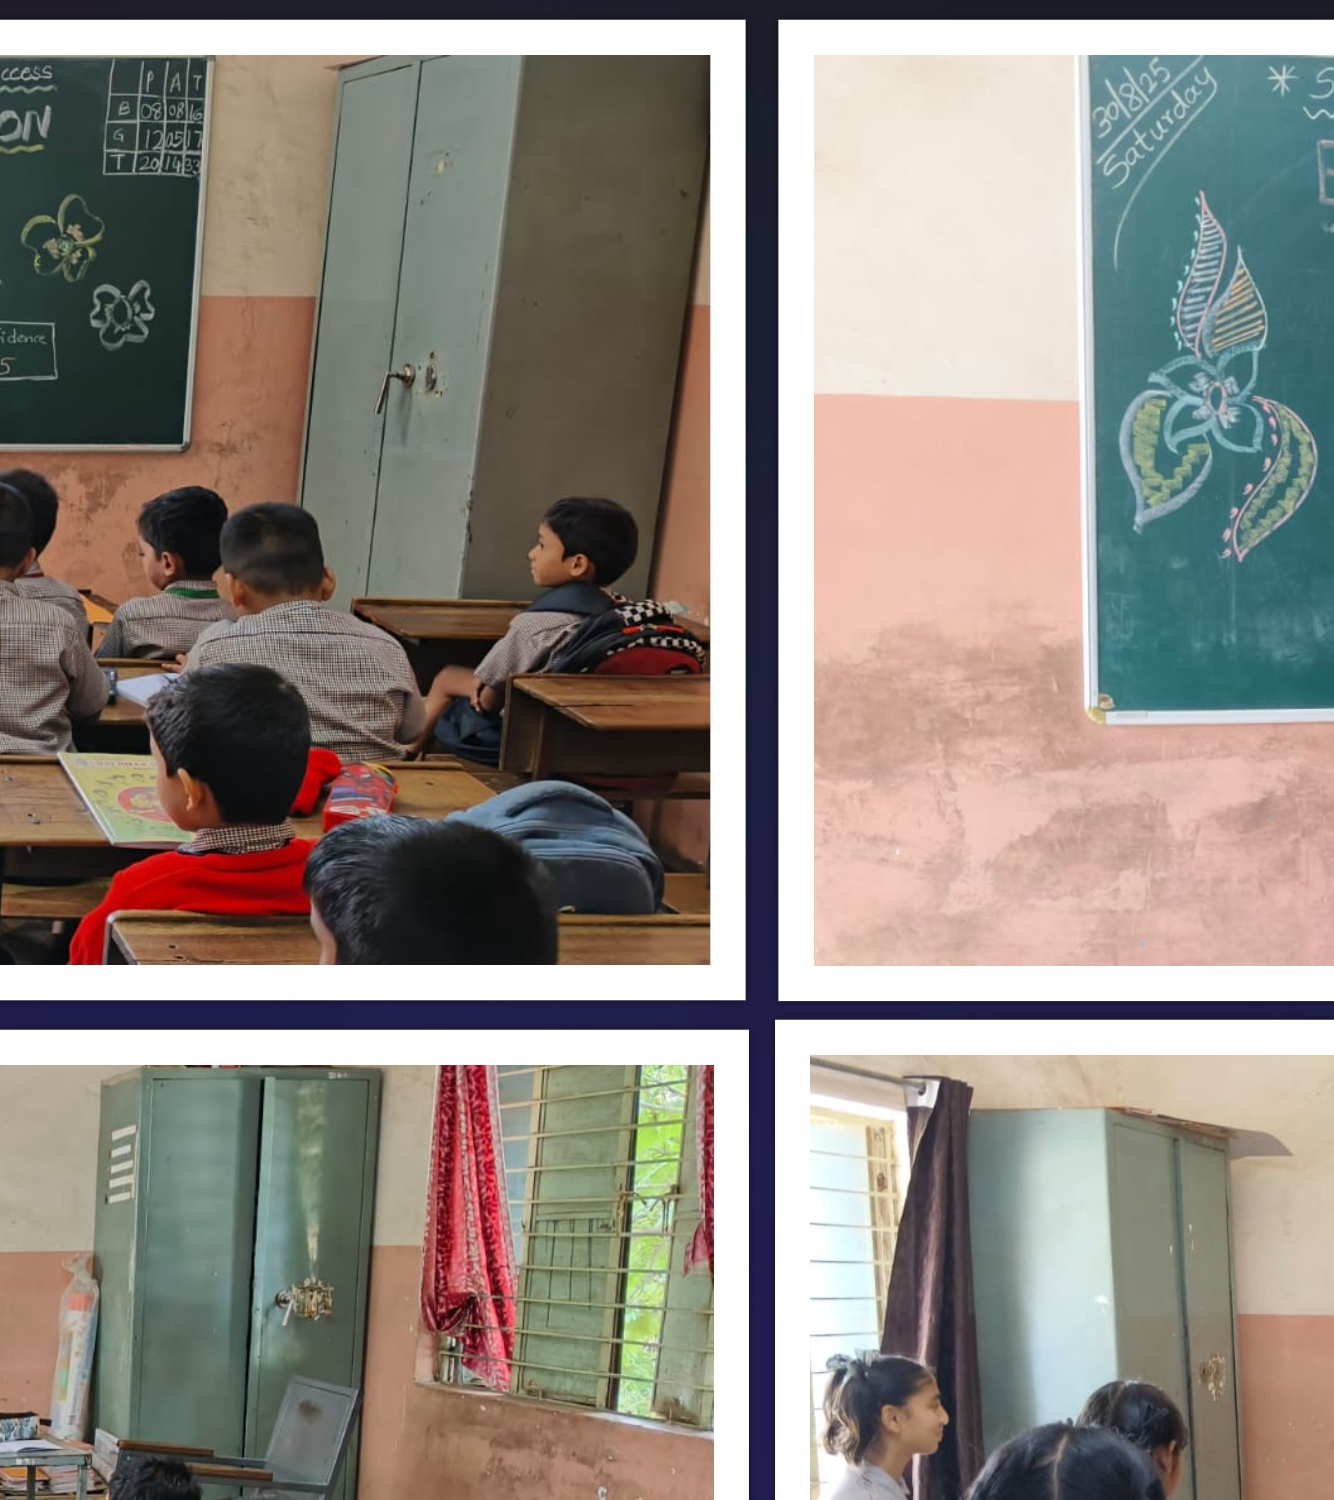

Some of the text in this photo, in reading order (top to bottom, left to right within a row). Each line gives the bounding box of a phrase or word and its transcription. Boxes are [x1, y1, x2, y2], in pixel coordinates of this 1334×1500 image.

[146, 70, 202, 93] P A T
[1092, 57, 1171, 137] 30/8/25
[118, 101, 203, 120] B 08 08 16
[1102, 66, 1218, 189] Saturday
[113, 128, 203, 150] G 12 05 17
[109, 154, 125, 170] T
[139, 156, 159, 170] 20
[165, 155, 181, 173] 14
[0, 357, 16, 375] 5
